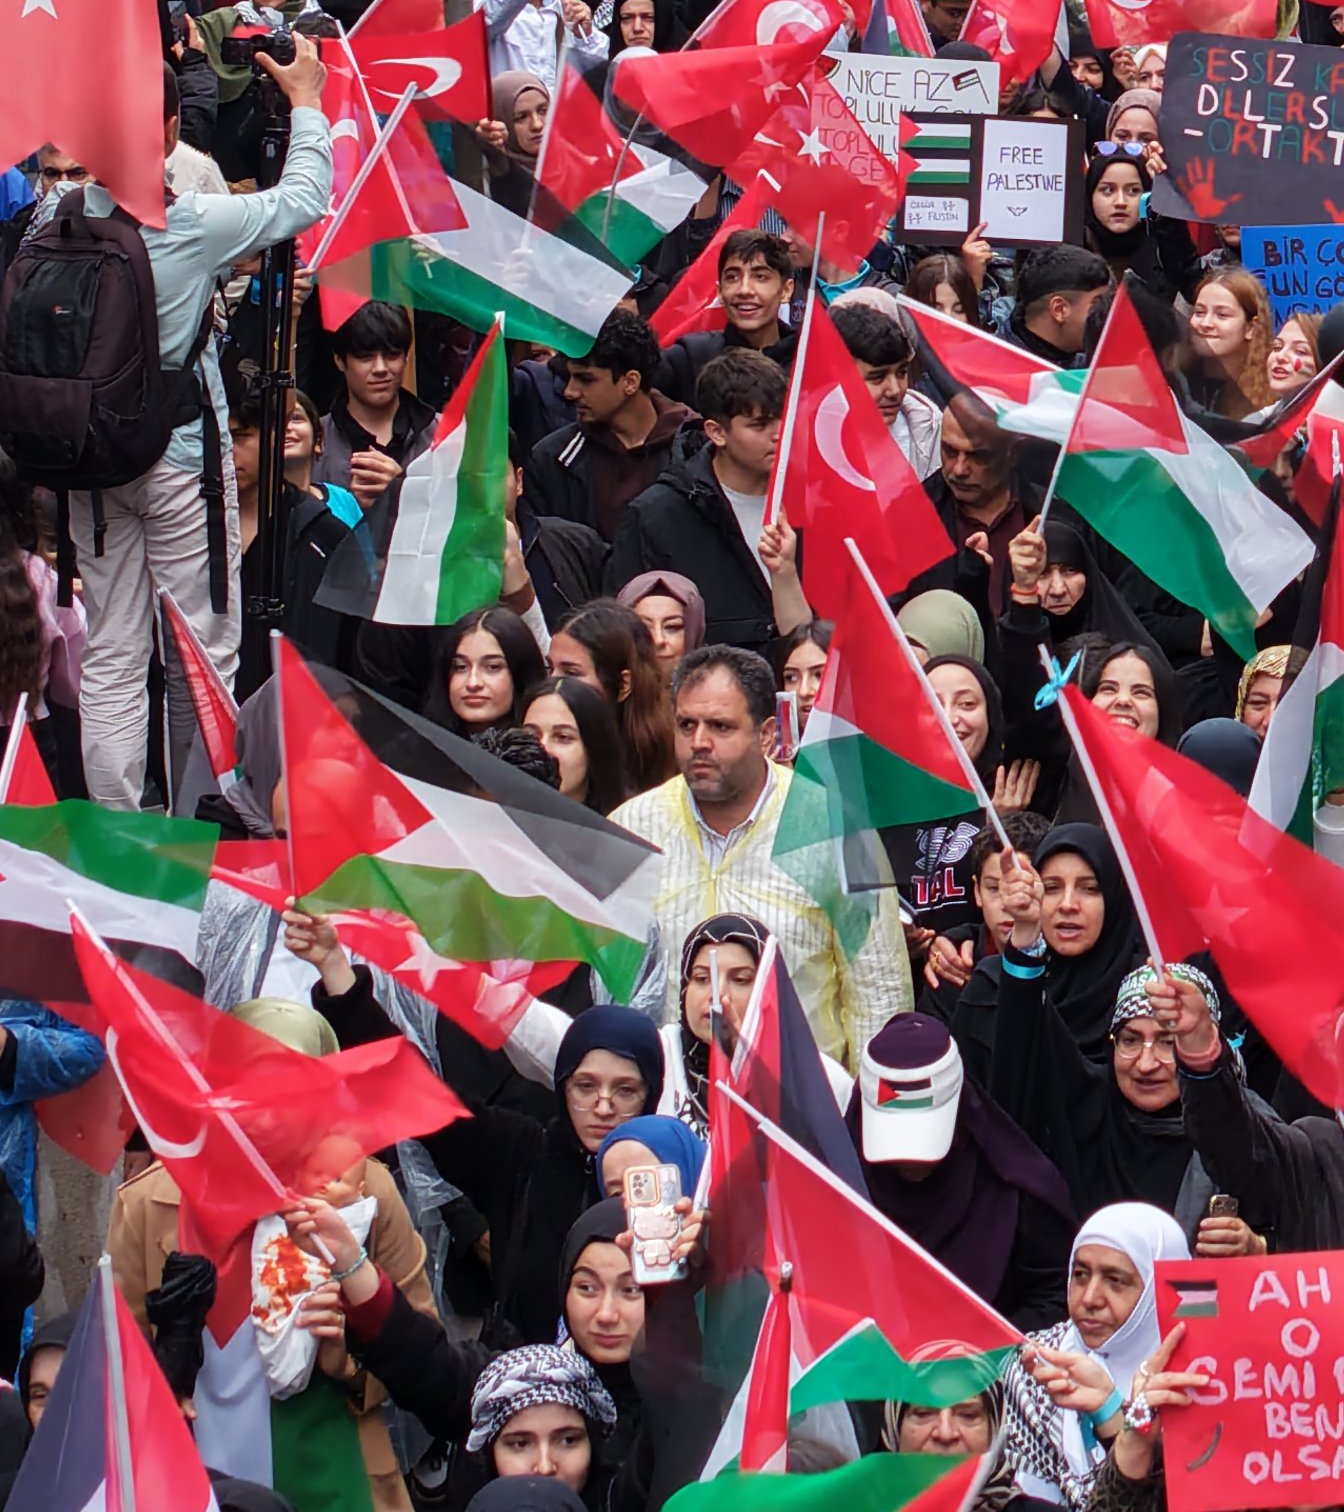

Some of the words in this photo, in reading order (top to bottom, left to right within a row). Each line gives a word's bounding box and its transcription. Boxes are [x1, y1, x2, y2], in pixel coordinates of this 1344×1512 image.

[914, 69, 953, 102] AZ
[1000, 146, 1043, 165] FREE
[987, 172, 1063, 193] PALESTINE
[1263, 236, 1308, 267] BİR
[1249, 1267, 1331, 1312] AH
[1280, 1317, 1320, 1358] O
[1264, 1401, 1344, 1442] BEN
